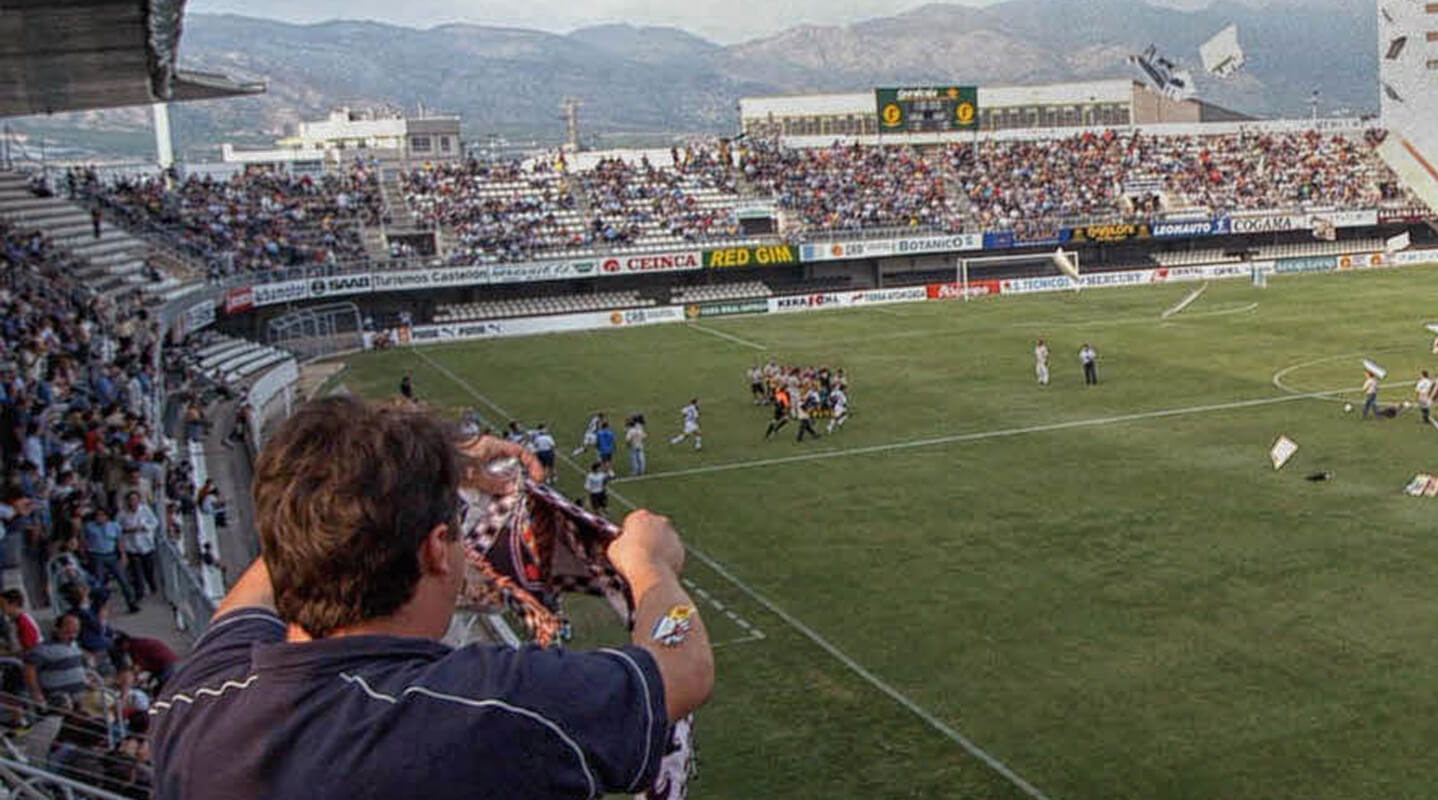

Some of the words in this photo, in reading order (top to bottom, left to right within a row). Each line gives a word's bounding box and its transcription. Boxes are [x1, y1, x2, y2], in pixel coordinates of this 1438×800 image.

[627, 254, 697, 271] CEINCA
[710, 249, 749, 268] RED
[756, 245, 794, 264] GIM
[328, 275, 369, 291] SAAB
